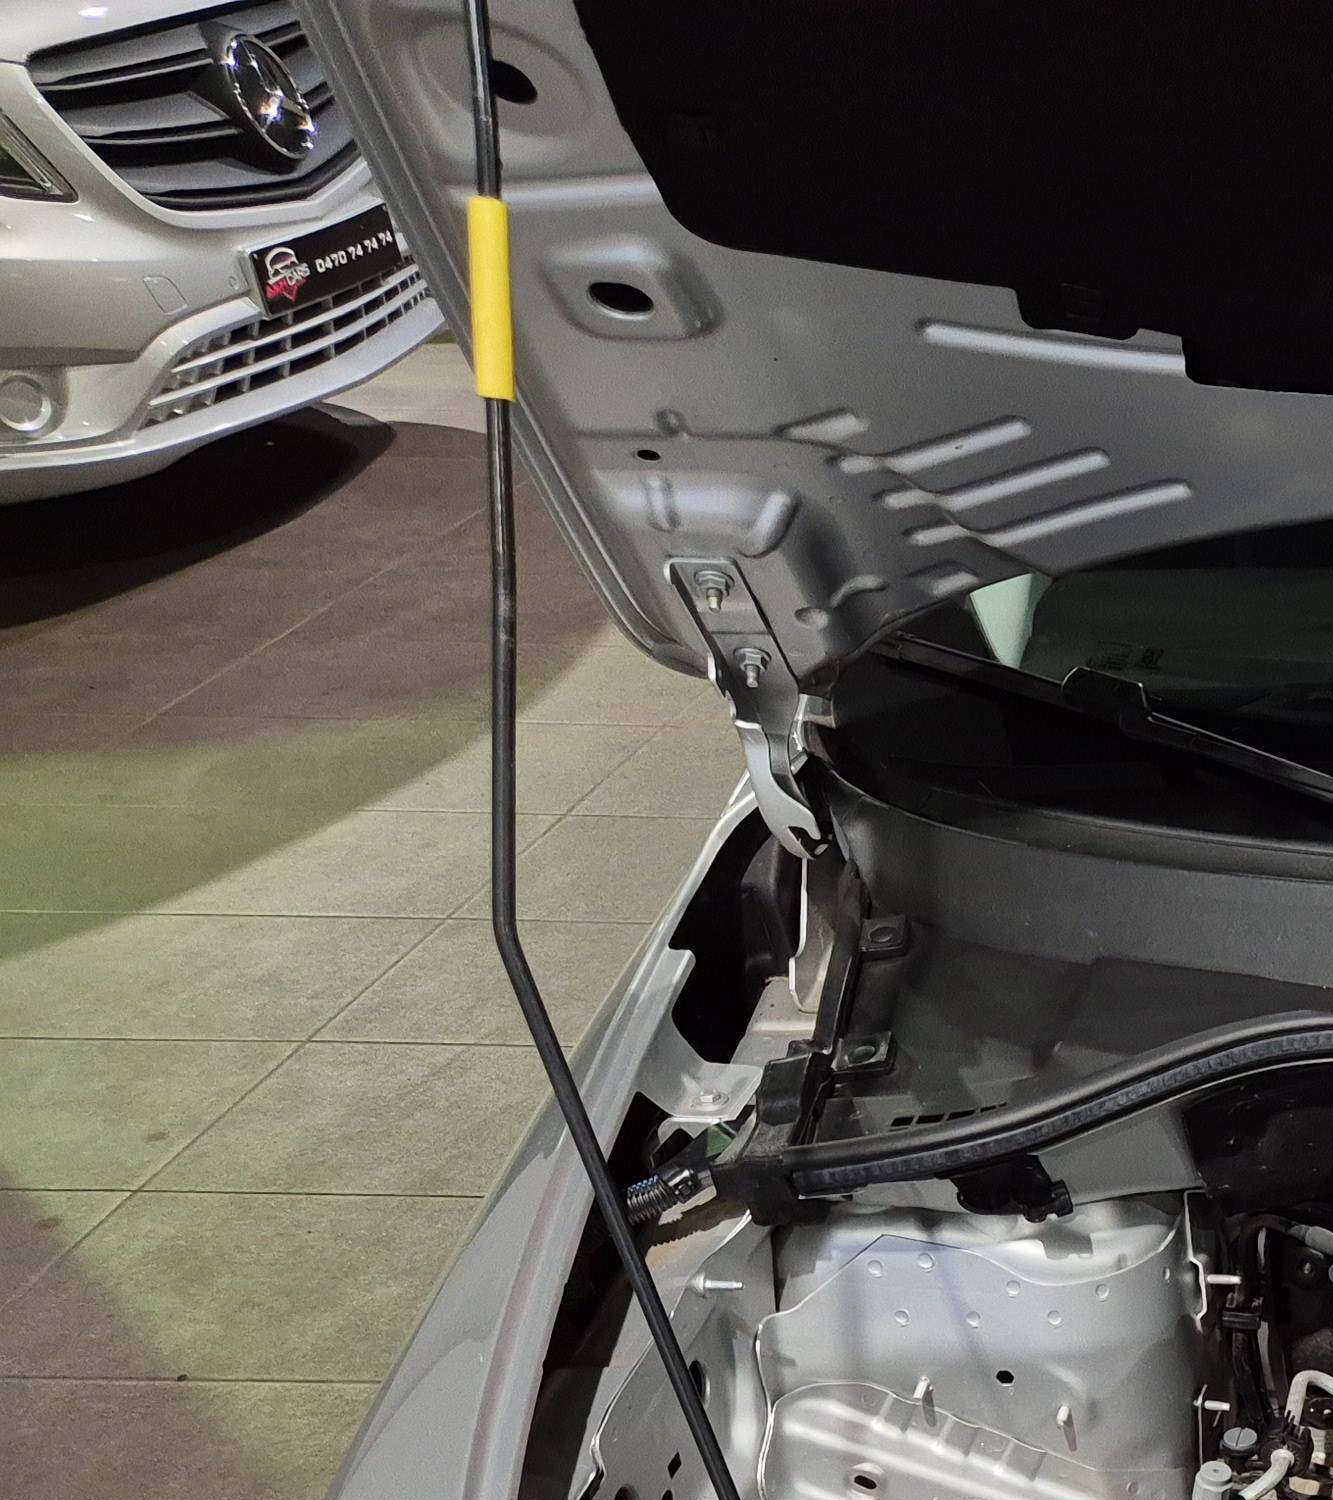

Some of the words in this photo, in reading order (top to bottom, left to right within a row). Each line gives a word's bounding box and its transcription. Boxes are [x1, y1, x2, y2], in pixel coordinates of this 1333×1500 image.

[315, 251, 348, 274] 0470
[347, 245, 364, 261] 74
[363, 237, 379, 254] 74
[377, 229, 393, 247] 74
